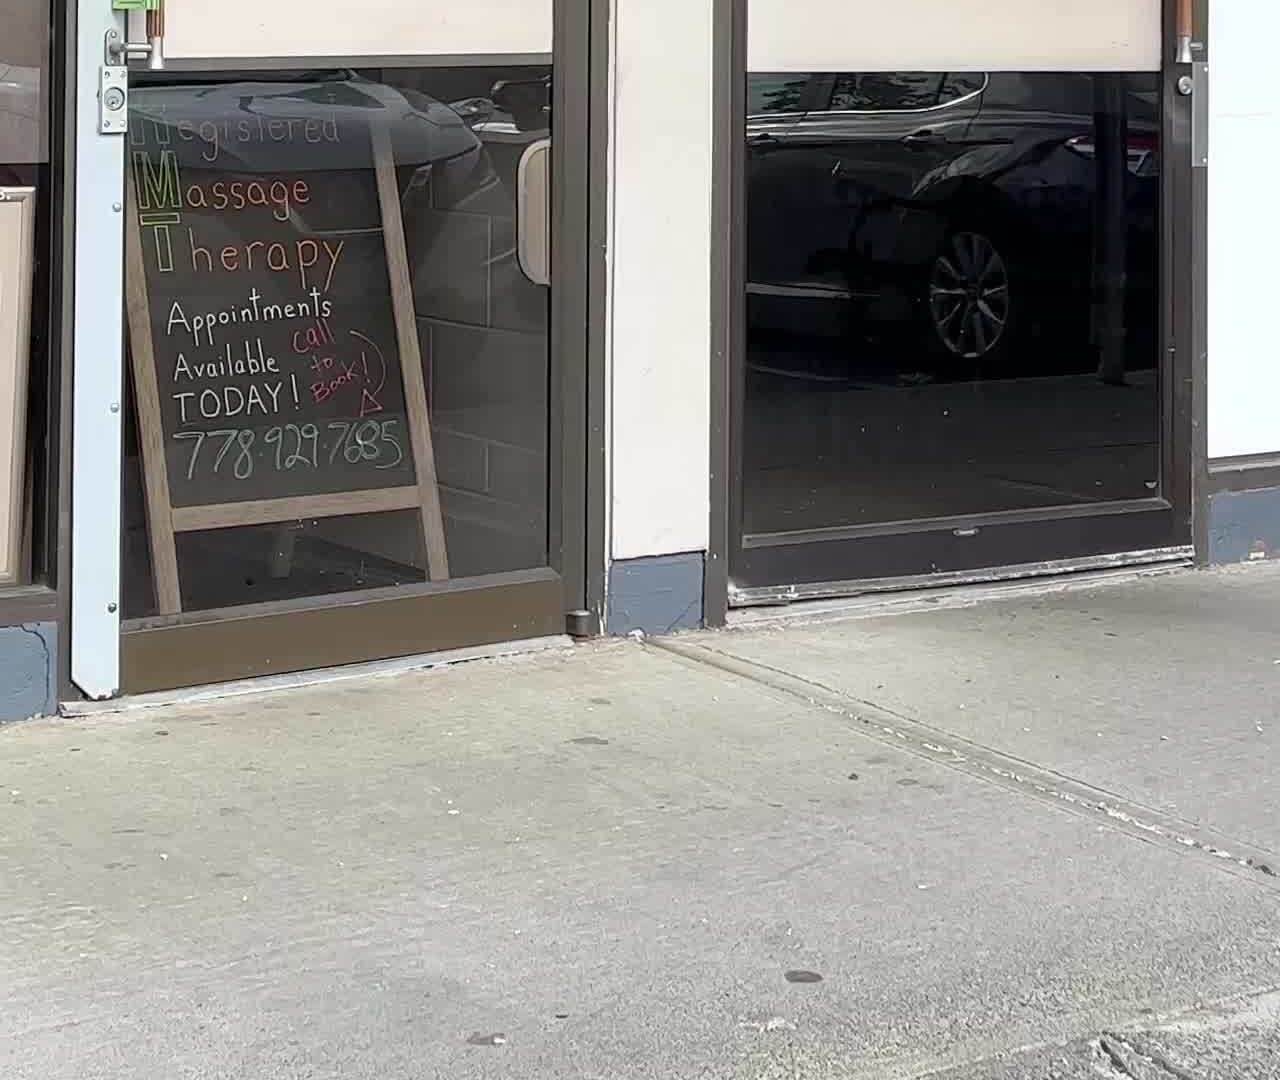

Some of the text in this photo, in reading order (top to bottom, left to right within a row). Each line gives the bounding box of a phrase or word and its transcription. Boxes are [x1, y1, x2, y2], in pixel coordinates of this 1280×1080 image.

[133, 150, 310, 221] Massage
[140, 212, 344, 293] Therapy
[167, 288, 332, 347] Appointments
[174, 338, 280, 381] Available
[310, 354, 334, 372] to
[173, 374, 300, 422] TODAY!
